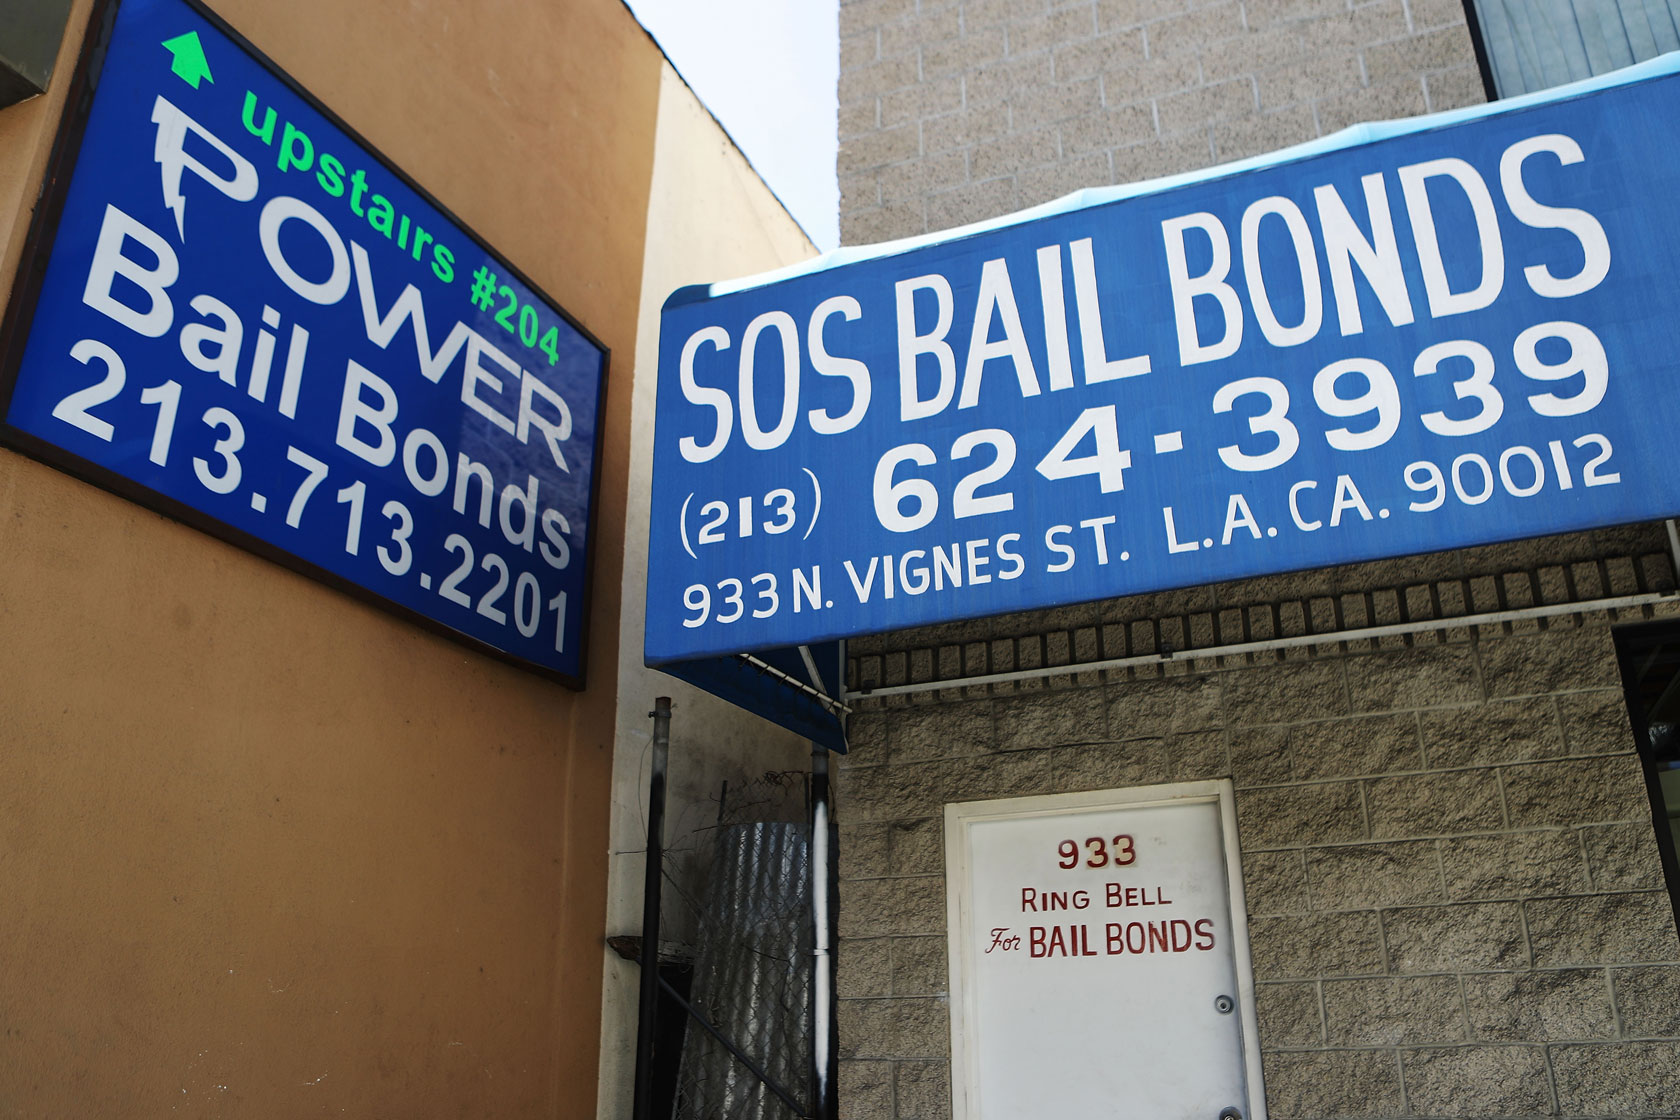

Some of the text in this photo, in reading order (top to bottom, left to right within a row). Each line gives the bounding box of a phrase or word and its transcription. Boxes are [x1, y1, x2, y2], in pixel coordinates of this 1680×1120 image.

[151, 94, 573, 475] POWER
[241, 90, 559, 366] upstairs #204
[679, 133, 1611, 464] SOS BAIL BONDS
[52, 339, 567, 654] 213.713.2201
[82, 204, 571, 570] Bail Bonds
[680, 320, 1609, 559] (213) 624-3939
[682, 572, 779, 628] 933
[792, 565, 833, 613] N.
[843, 533, 1024, 603] VIGNES
[1045, 515, 1130, 573] ST.
[1404, 433, 1621, 513] 90012
[985, 919, 1216, 958] For BAIL BONDS
[1058, 834, 1137, 869] 933
